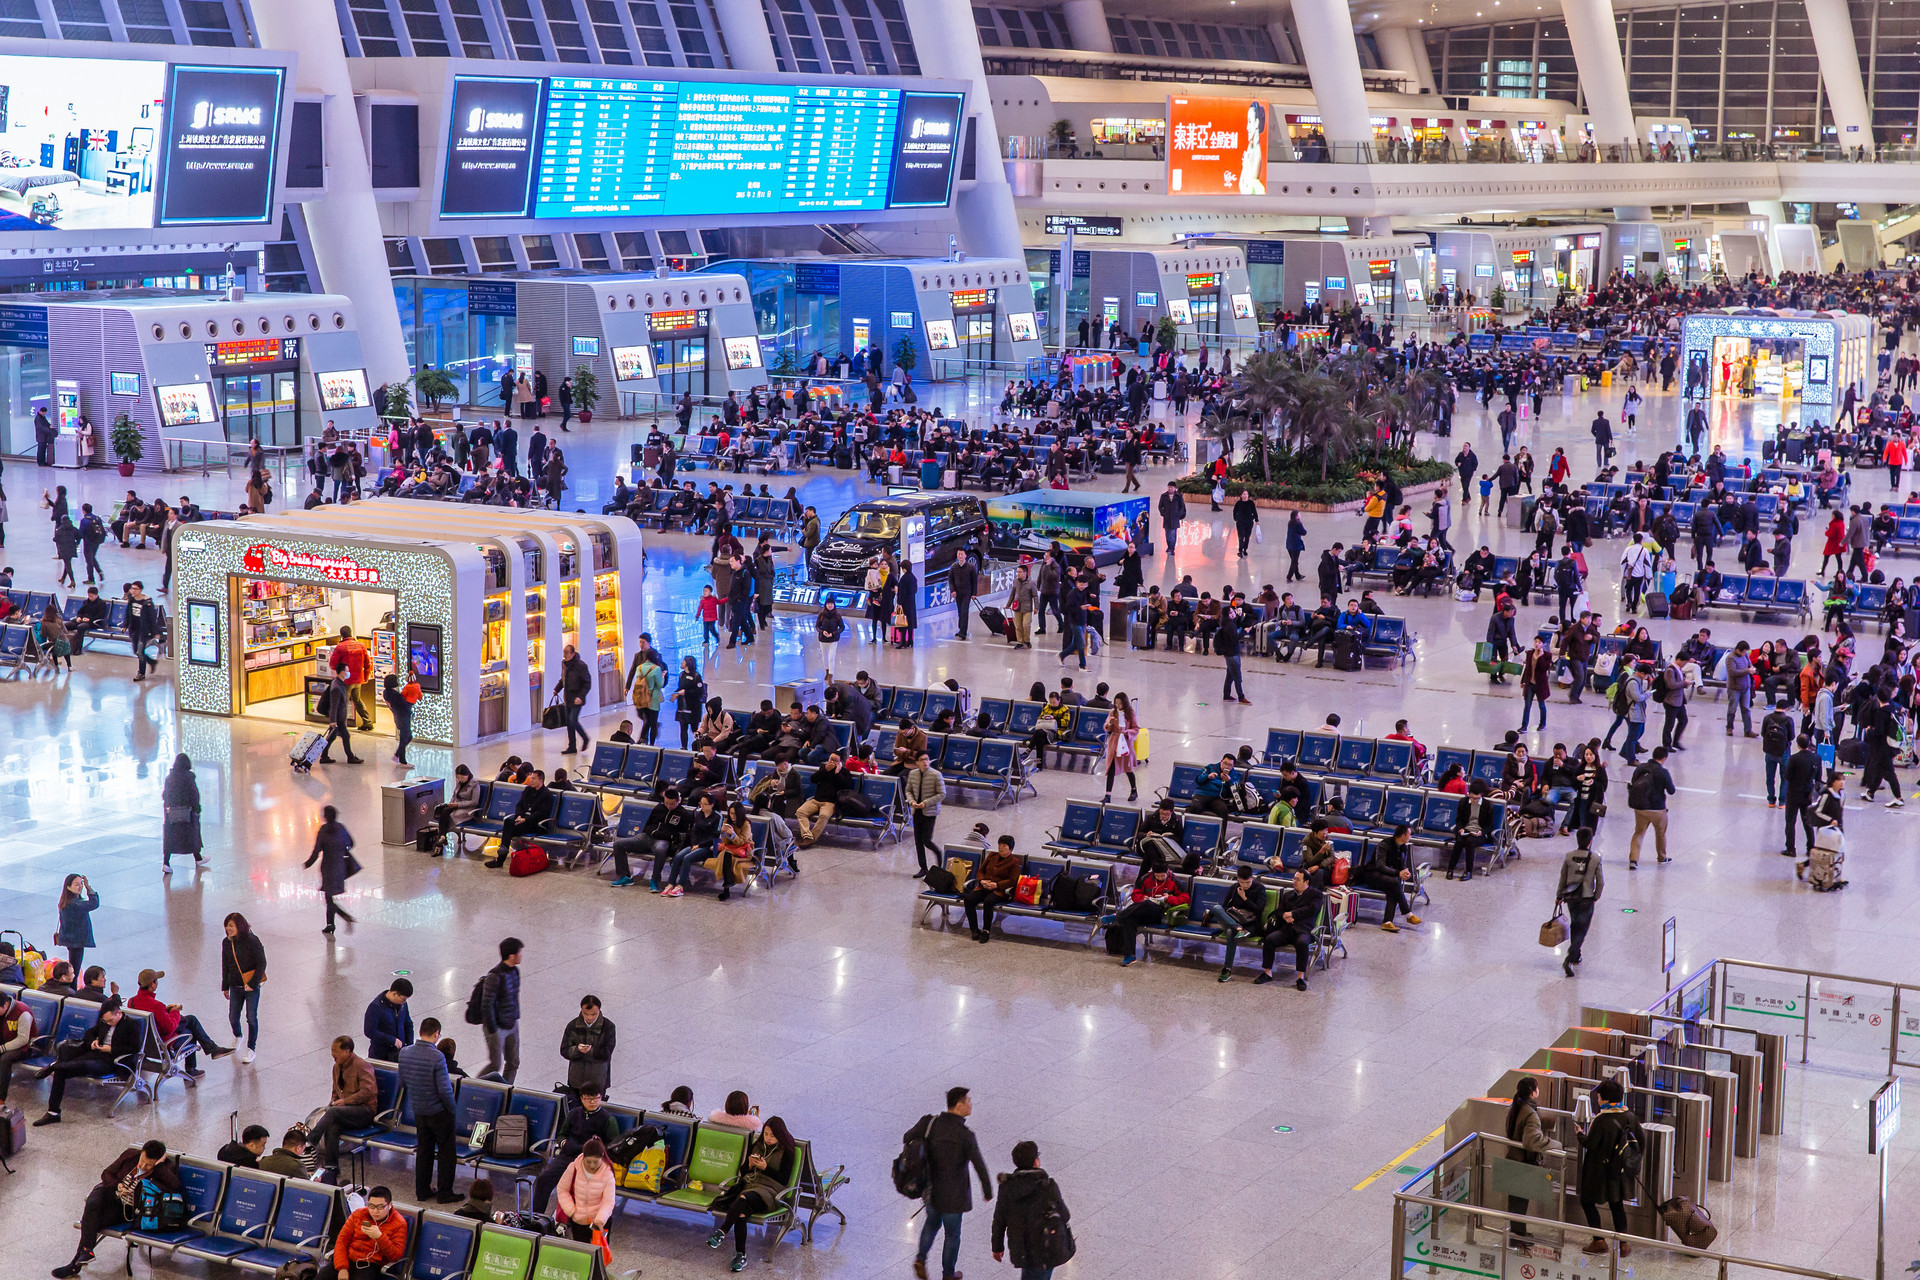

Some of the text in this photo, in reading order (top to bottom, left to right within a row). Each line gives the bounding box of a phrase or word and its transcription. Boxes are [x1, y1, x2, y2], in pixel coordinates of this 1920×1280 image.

[55, 259, 80, 271] 北出口 2
[284, 347, 298, 359] 17A
[271, 551, 357, 572] Big train impression
[1432, 1245, 1468, 1259] 中国人寿
[1432, 1252, 1467, 1264] CHINA LIFE
